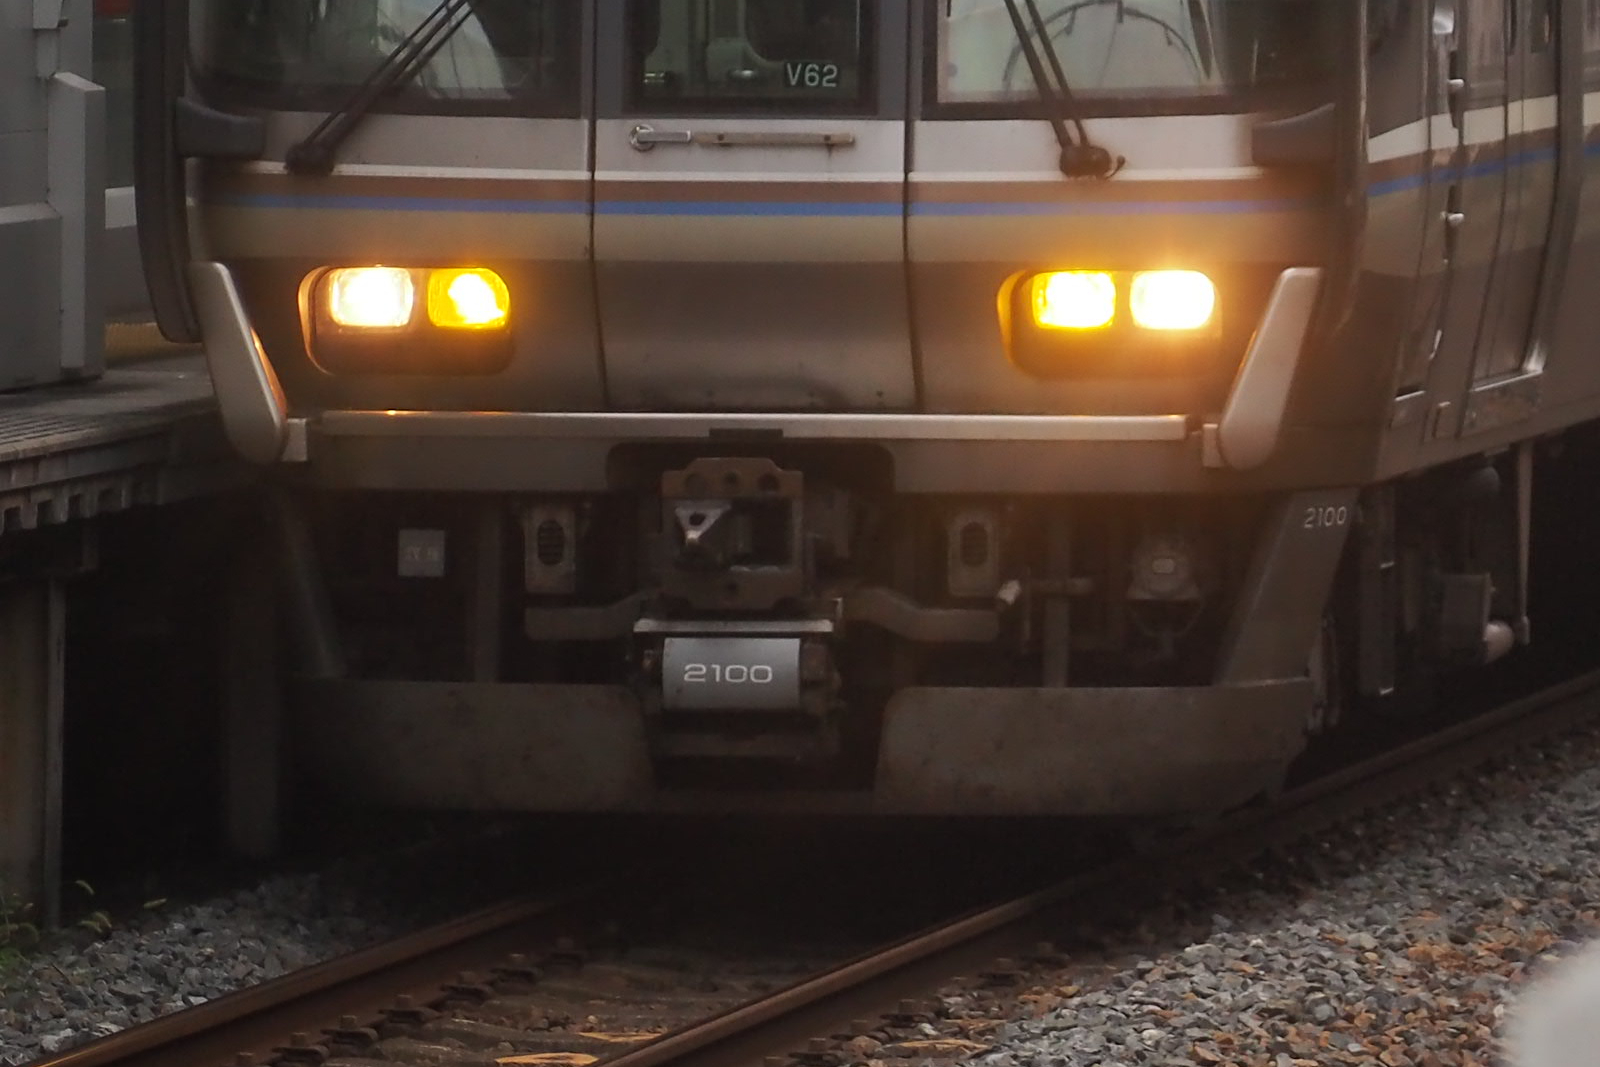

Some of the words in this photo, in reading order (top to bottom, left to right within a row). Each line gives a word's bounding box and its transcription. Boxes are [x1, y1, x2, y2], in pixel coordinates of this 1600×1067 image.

[786, 62, 838, 87] V62
[1304, 505, 1347, 529] 2100
[683, 663, 773, 683] 2100
